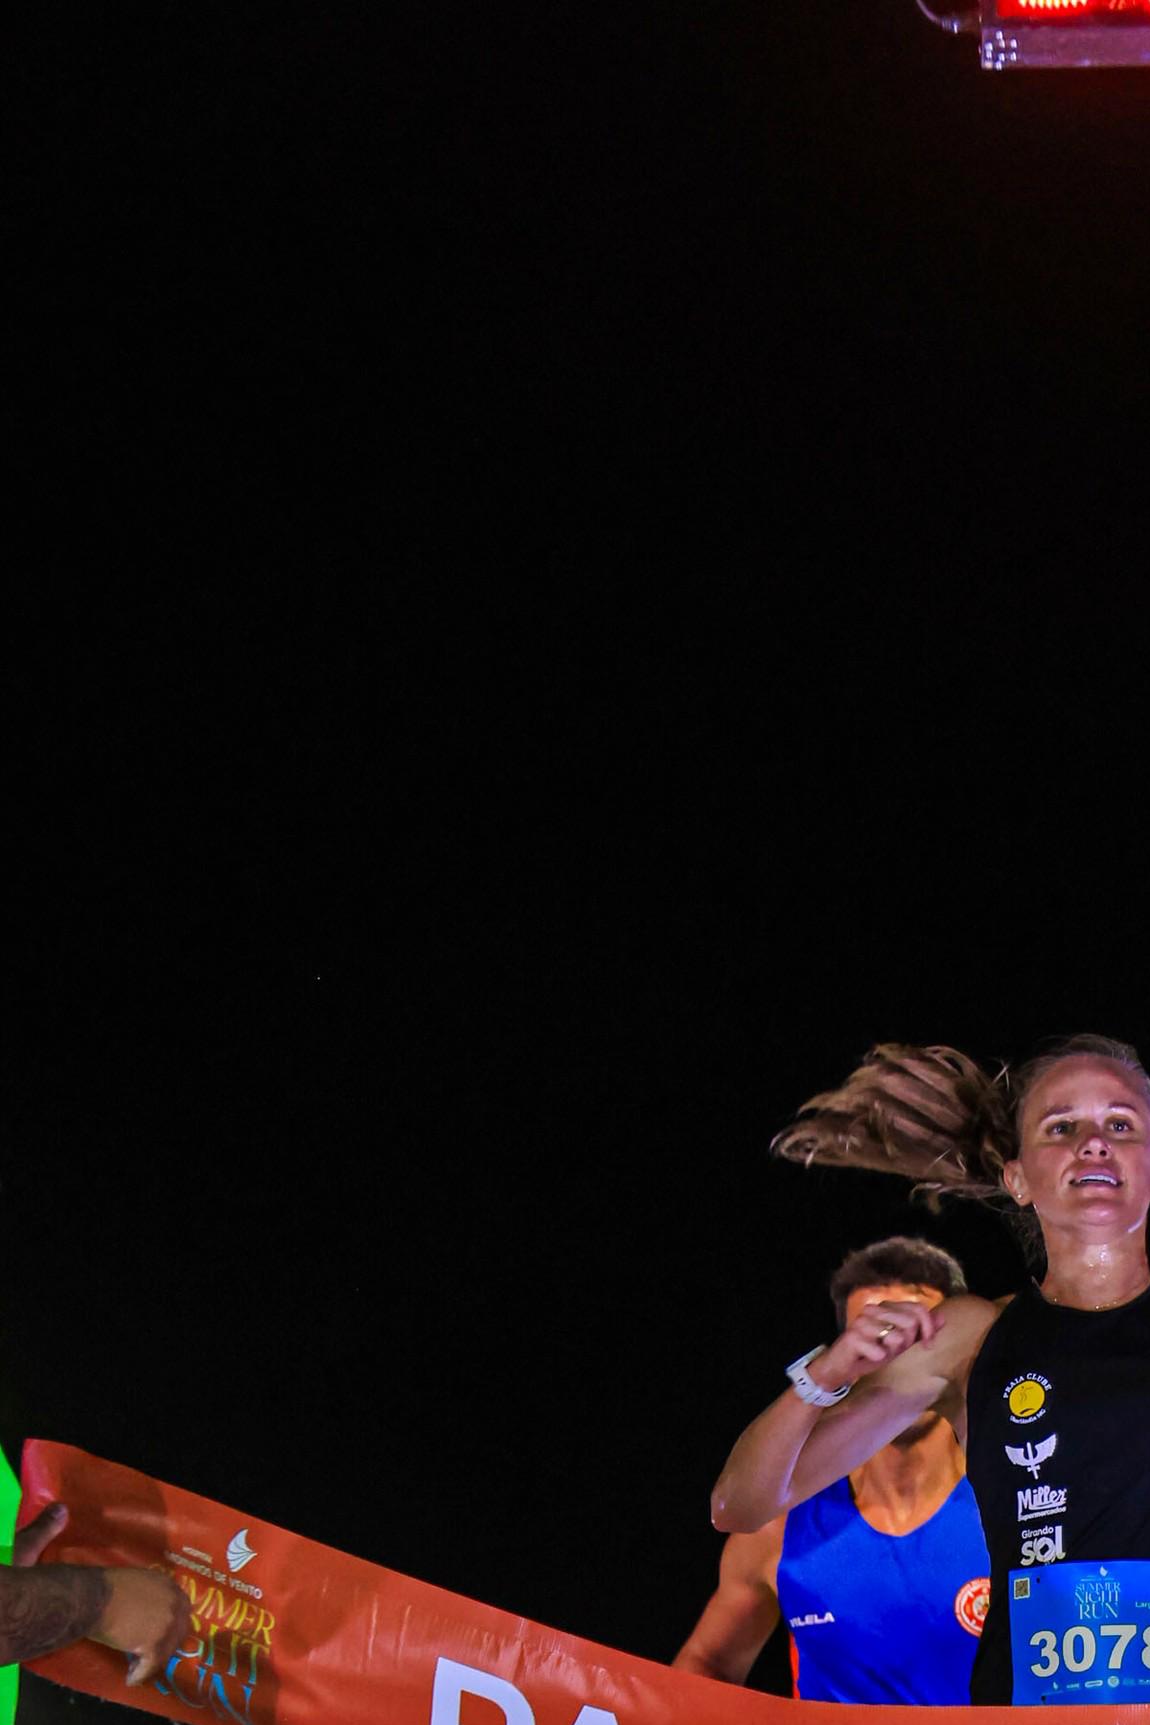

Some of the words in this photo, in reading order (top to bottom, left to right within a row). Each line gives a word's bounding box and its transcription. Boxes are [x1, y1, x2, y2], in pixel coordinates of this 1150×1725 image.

[1002, 1376, 1025, 1399] PRAIA
[1026, 1372, 1052, 1391] CLUBE
[1017, 1485, 1067, 1513] Miller
[1021, 1525, 1054, 1539] Girando
